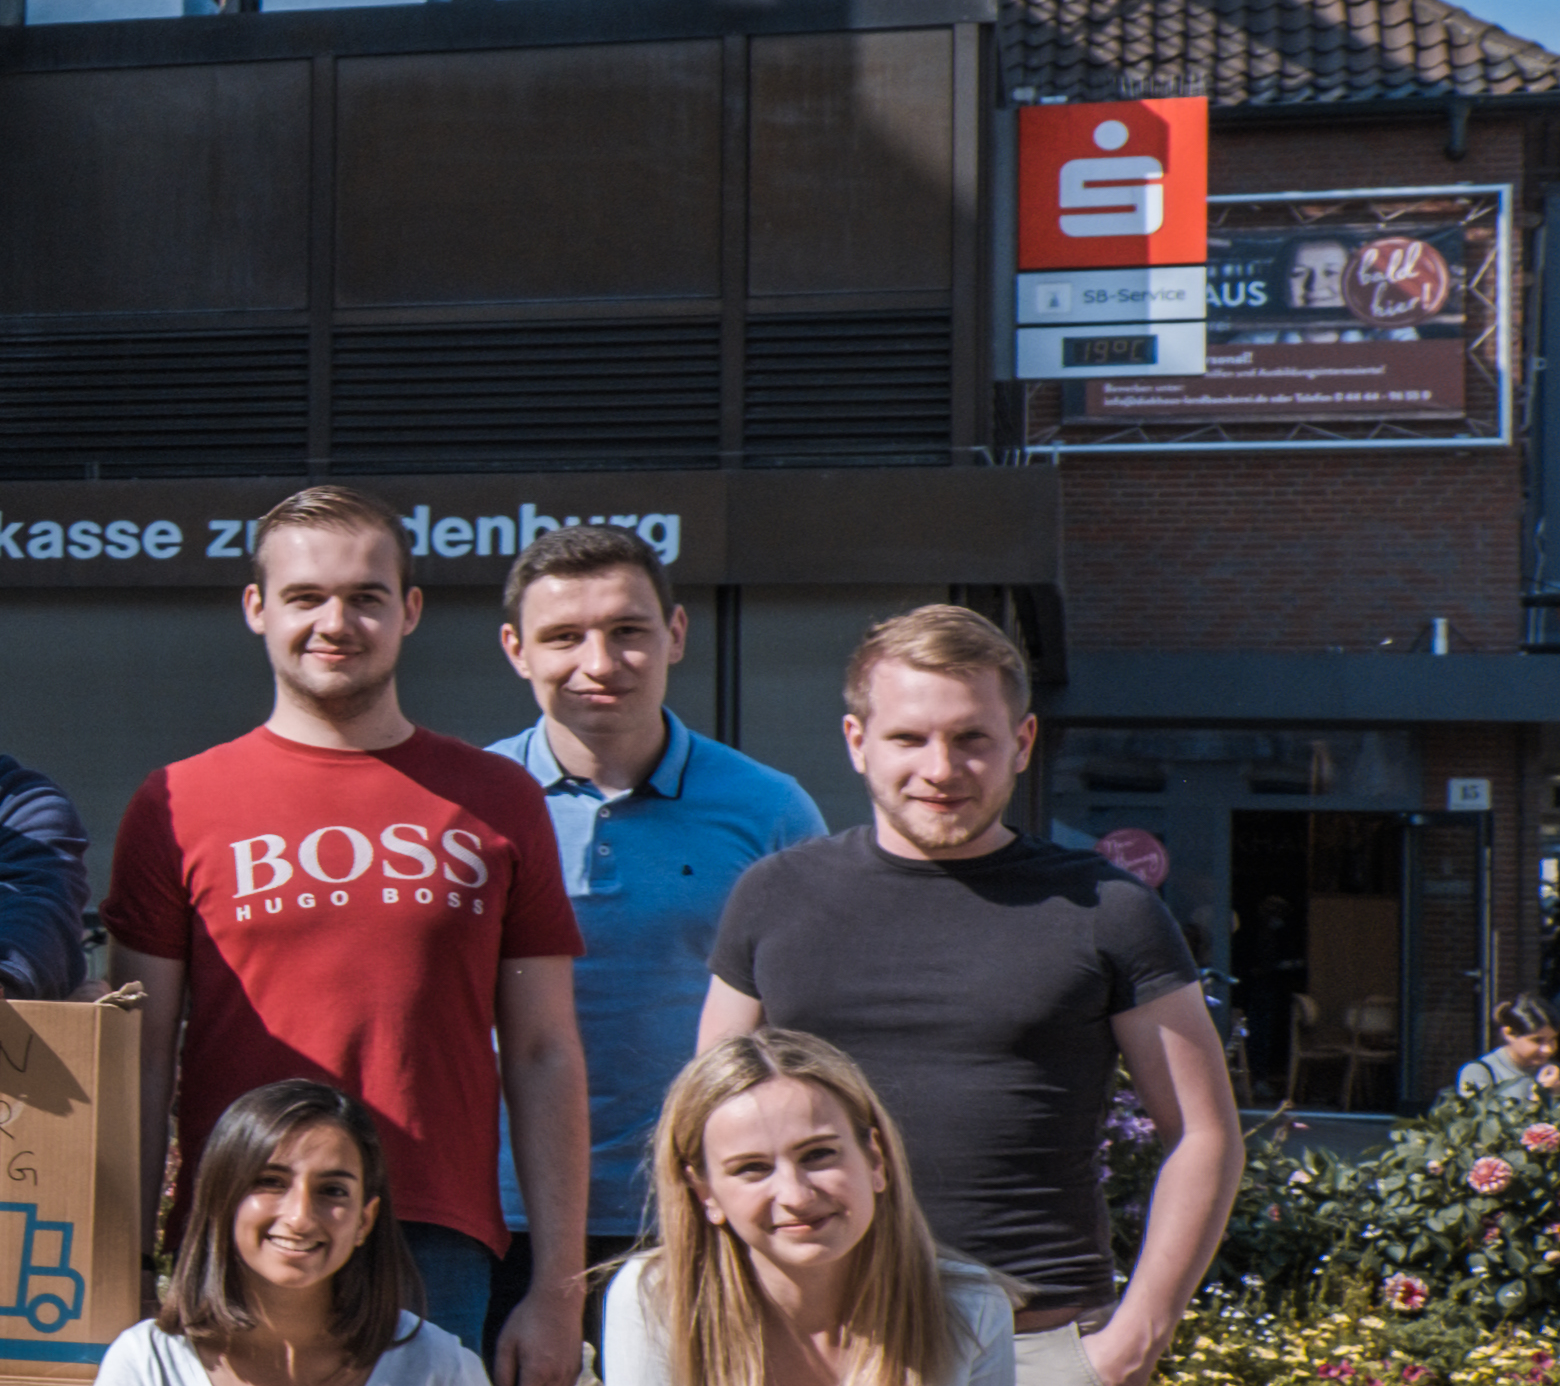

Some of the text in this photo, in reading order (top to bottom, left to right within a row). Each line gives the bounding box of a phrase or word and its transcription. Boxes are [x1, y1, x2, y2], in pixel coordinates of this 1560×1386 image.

[1083, 287, 1186, 305] SB-Service
[229, 823, 489, 899] BOSS
[235, 886, 485, 922] HUGO BOSS
